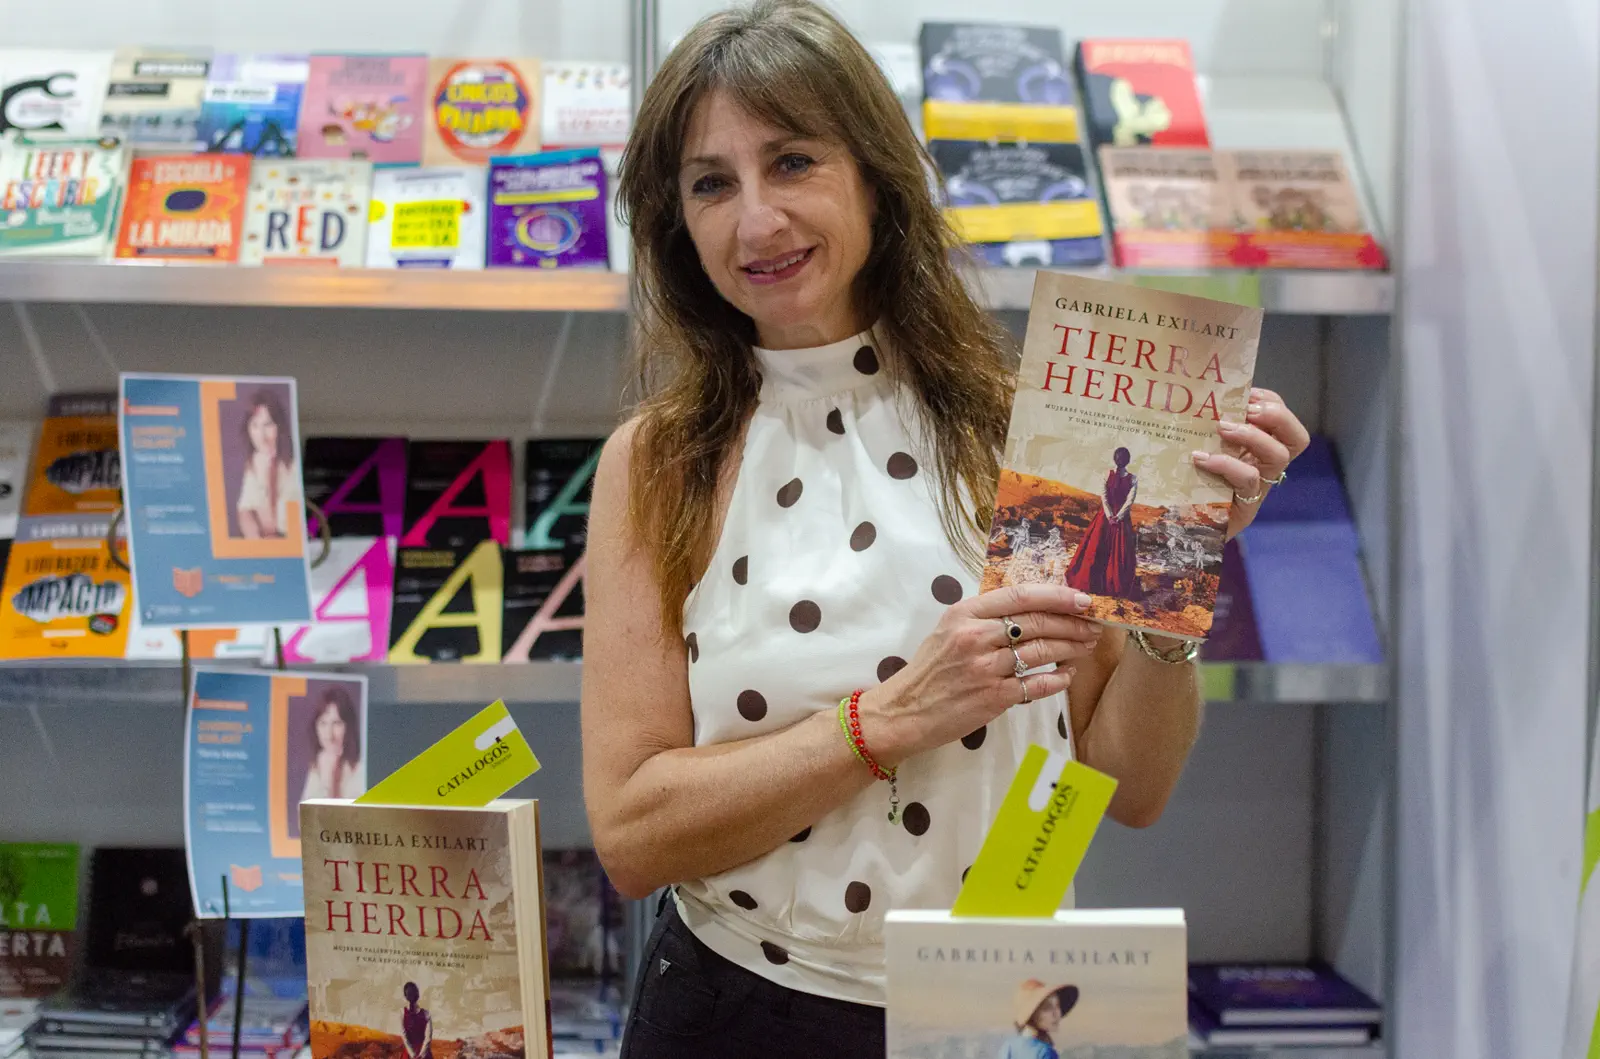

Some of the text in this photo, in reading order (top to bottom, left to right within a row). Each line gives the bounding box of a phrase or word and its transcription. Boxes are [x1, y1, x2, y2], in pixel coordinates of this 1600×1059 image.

[129, 221, 154, 247] LA
[266, 205, 346, 250] RED
[1055, 297, 1239, 340] GABRIELA EXILART
[1053, 323, 1226, 384] TIERRA
[1041, 361, 1220, 421] HERIDA
[1044, 403, 1077, 414] MUJERES
[1125, 418, 1160, 429] HOMBRES
[1155, 433, 1186, 442] MARCHA
[399, 438, 512, 548] A
[388, 540, 503, 664] A
[437, 742, 510, 797] CATALOGOS
[320, 829, 488, 851] GABRIELA EXILART
[1015, 783, 1073, 890] CATALOGOS
[324, 859, 489, 900] TIERRA
[325, 899, 494, 941] HERIDA
[917, 947, 1151, 967] GABRIELA EXILART
